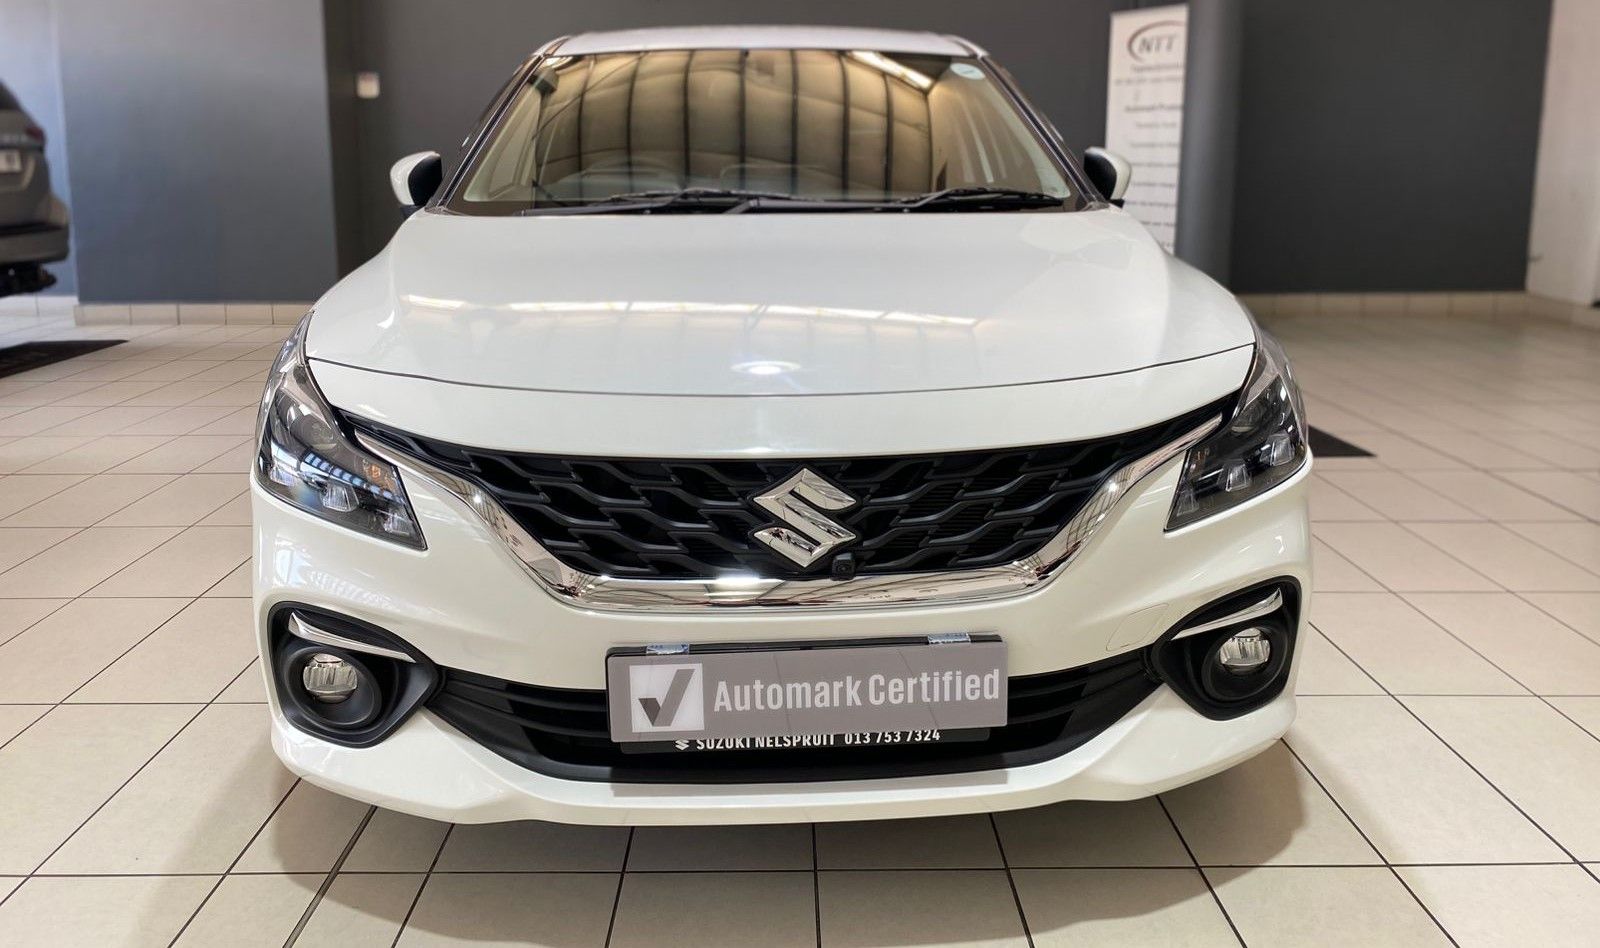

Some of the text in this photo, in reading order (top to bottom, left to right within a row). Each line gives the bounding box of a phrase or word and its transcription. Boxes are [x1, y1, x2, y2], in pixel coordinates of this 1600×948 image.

[713, 668, 1000, 712] Automark Certified
[696, 737, 750, 750] SUZUKI
[755, 734, 835, 748] NELSPRUIT
[844, 732, 871, 745] 013
